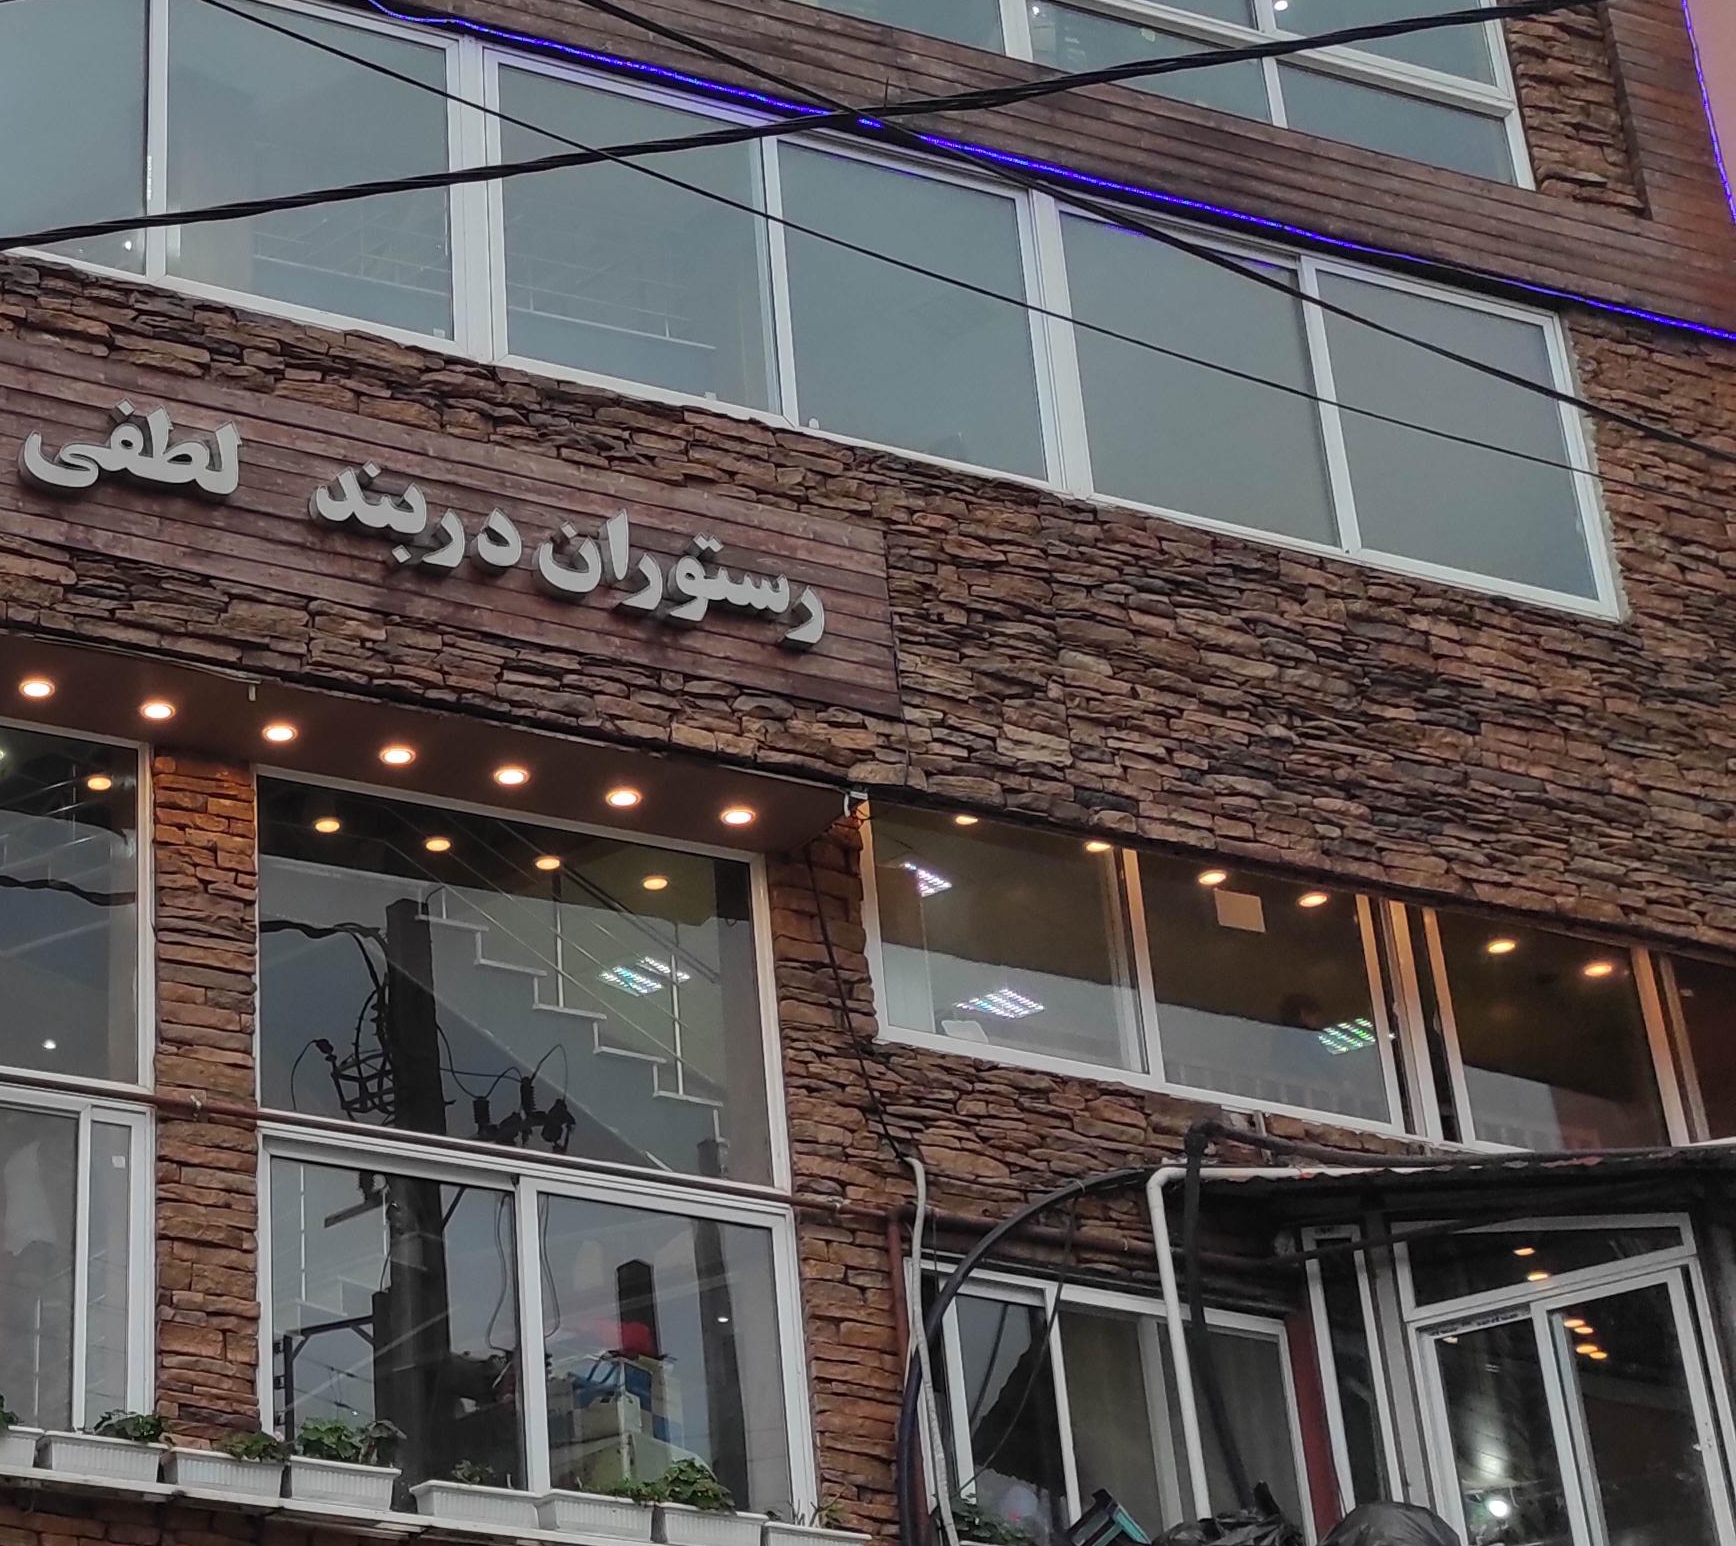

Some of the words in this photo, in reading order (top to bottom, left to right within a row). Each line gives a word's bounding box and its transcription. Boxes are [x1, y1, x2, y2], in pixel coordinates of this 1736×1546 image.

[20, 398, 243, 495] لطفی
[309, 460, 521, 571] دربند
[532, 507, 826, 649] رستوران
